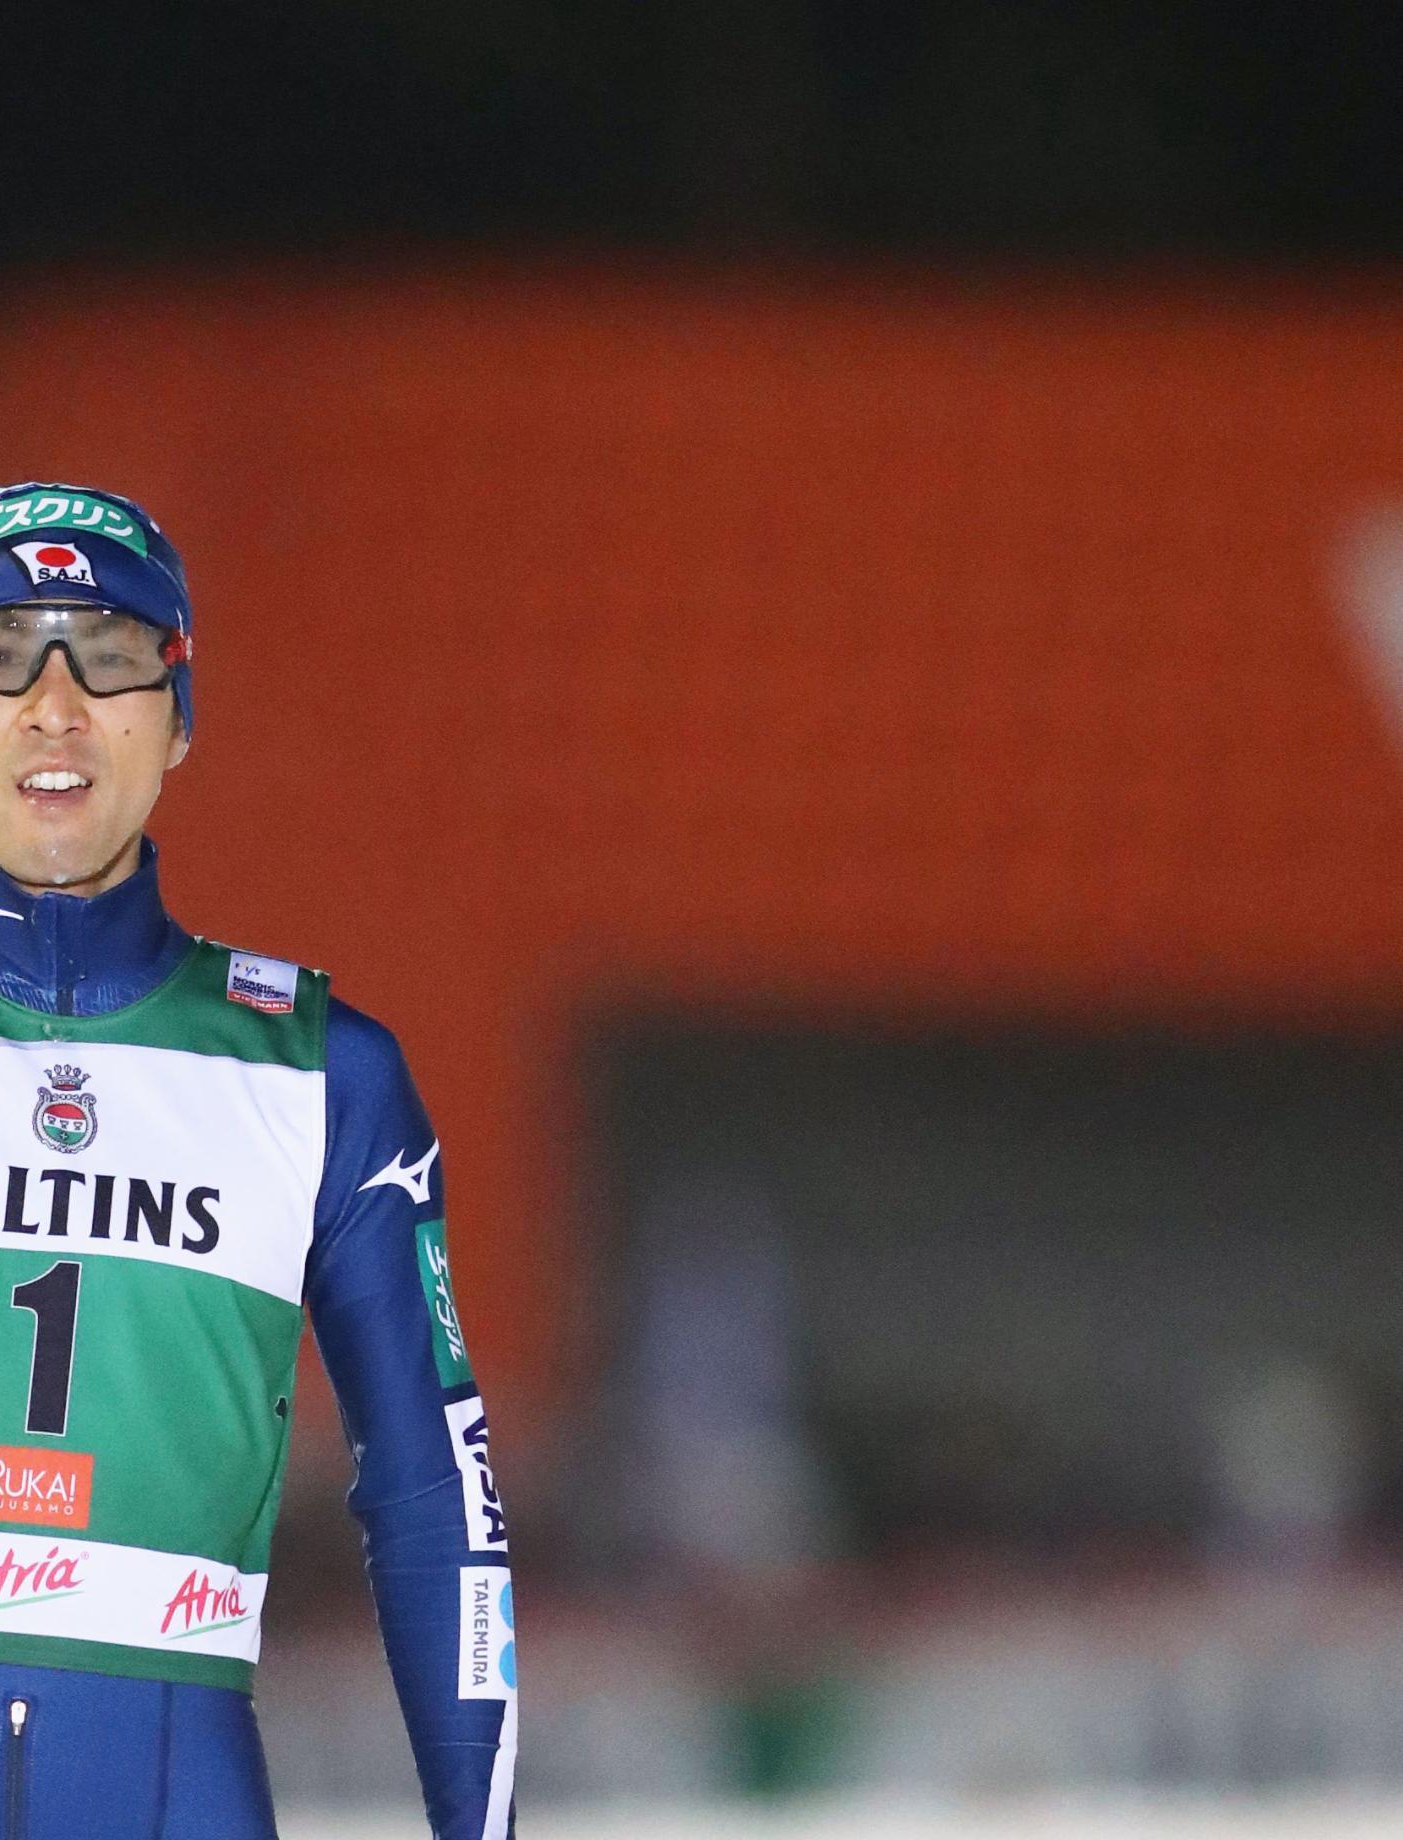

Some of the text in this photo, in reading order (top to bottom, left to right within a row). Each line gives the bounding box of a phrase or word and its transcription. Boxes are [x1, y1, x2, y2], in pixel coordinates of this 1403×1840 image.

[10, 1260, 82, 1437] 1
[160, 1569, 248, 1634] Atria
[473, 1578, 489, 1687] TAKEMURA
